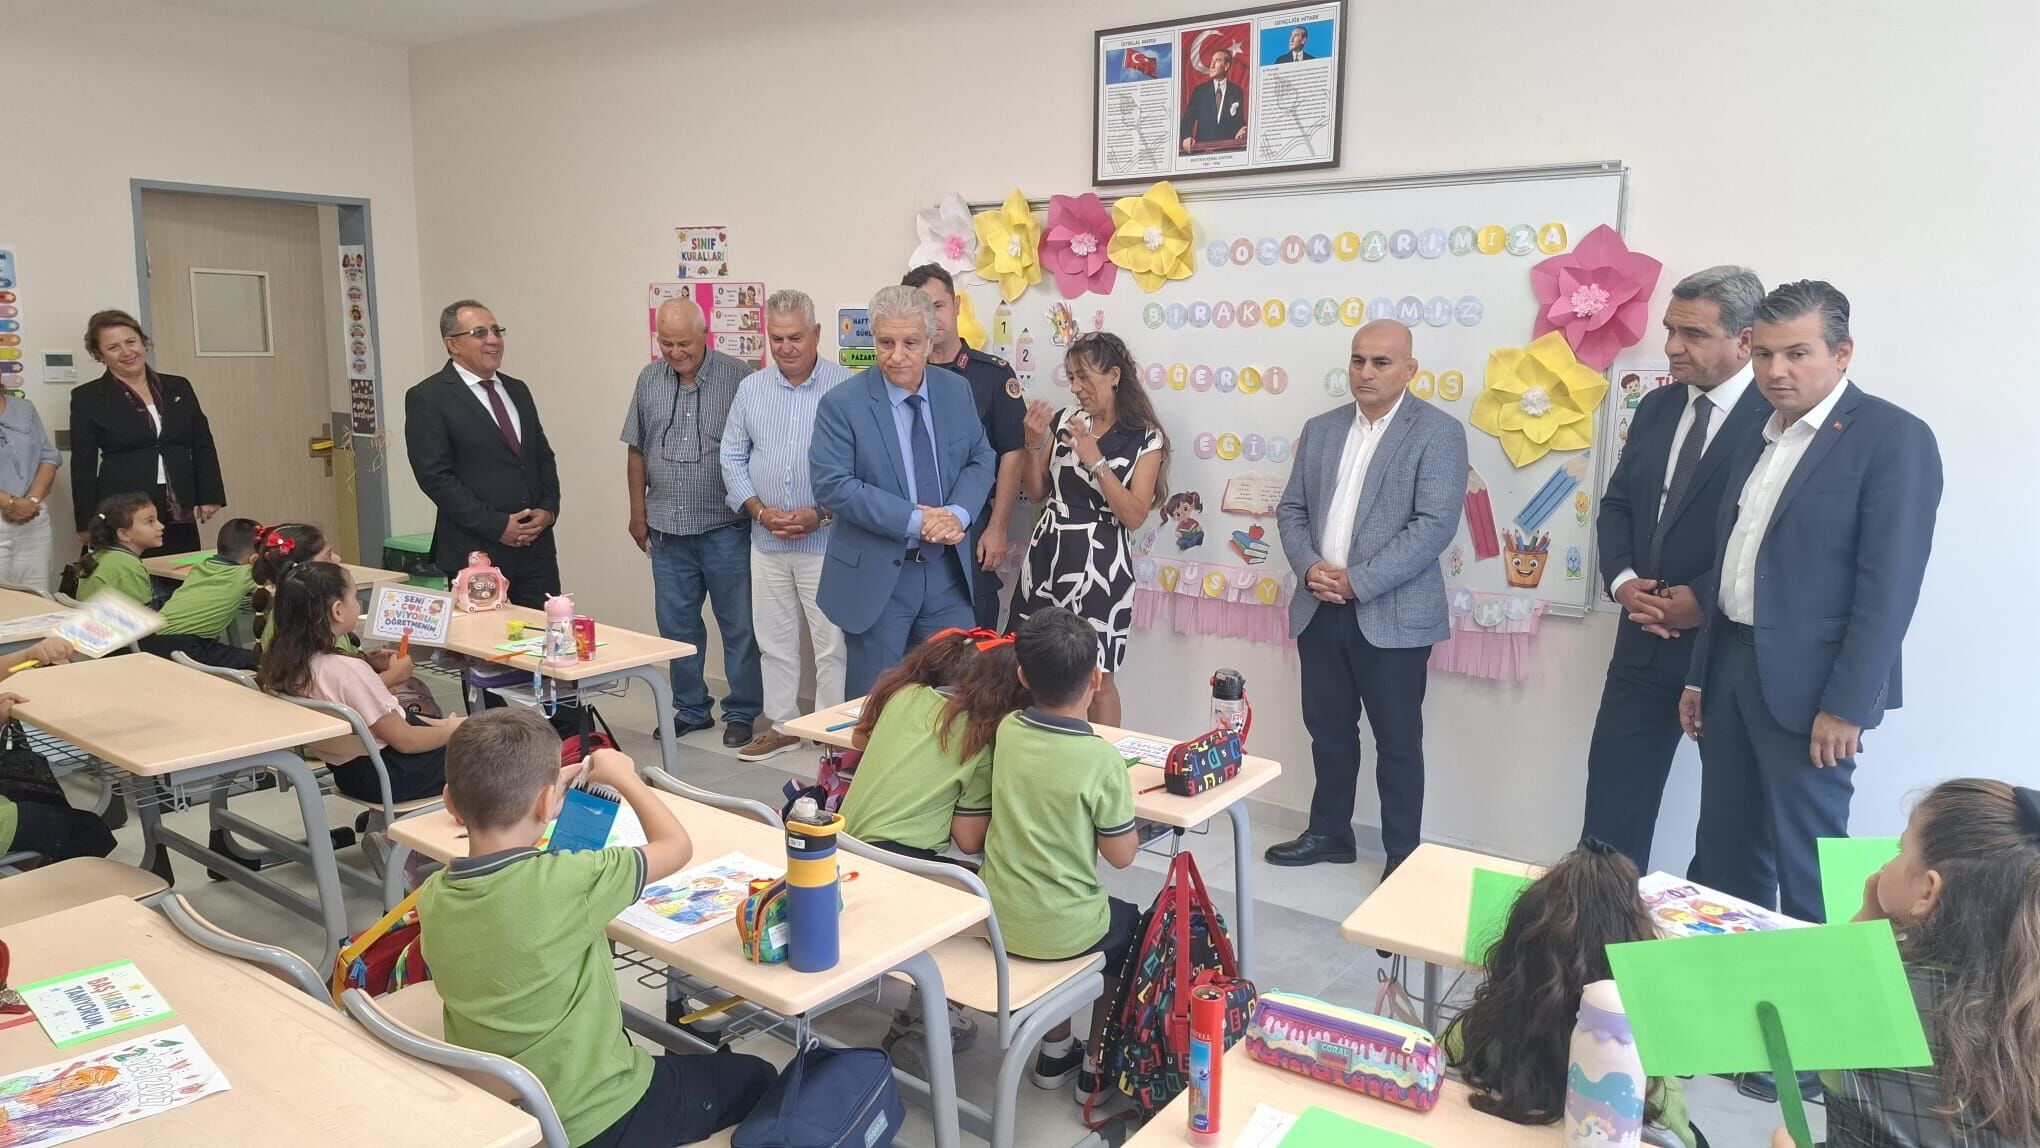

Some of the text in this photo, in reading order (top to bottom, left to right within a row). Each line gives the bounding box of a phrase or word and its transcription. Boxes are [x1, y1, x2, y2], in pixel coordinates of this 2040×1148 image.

[691, 237, 716, 250] SINIF
[681, 251, 724, 262] KURALLARI
[856, 328, 873, 337] GÜNL
[1000, 321, 1006, 335] 1
[1022, 349, 1029, 363] 2
[1329, 373, 1461, 395] MAS
[404, 595, 425, 605] SENİ
[383, 609, 439, 624] SEVİYORUM
[385, 617, 436, 632] ÖĞRETMENİM
[87, 976, 116, 994] BAŞ
[1321, 1043, 1350, 1058] CORAL
